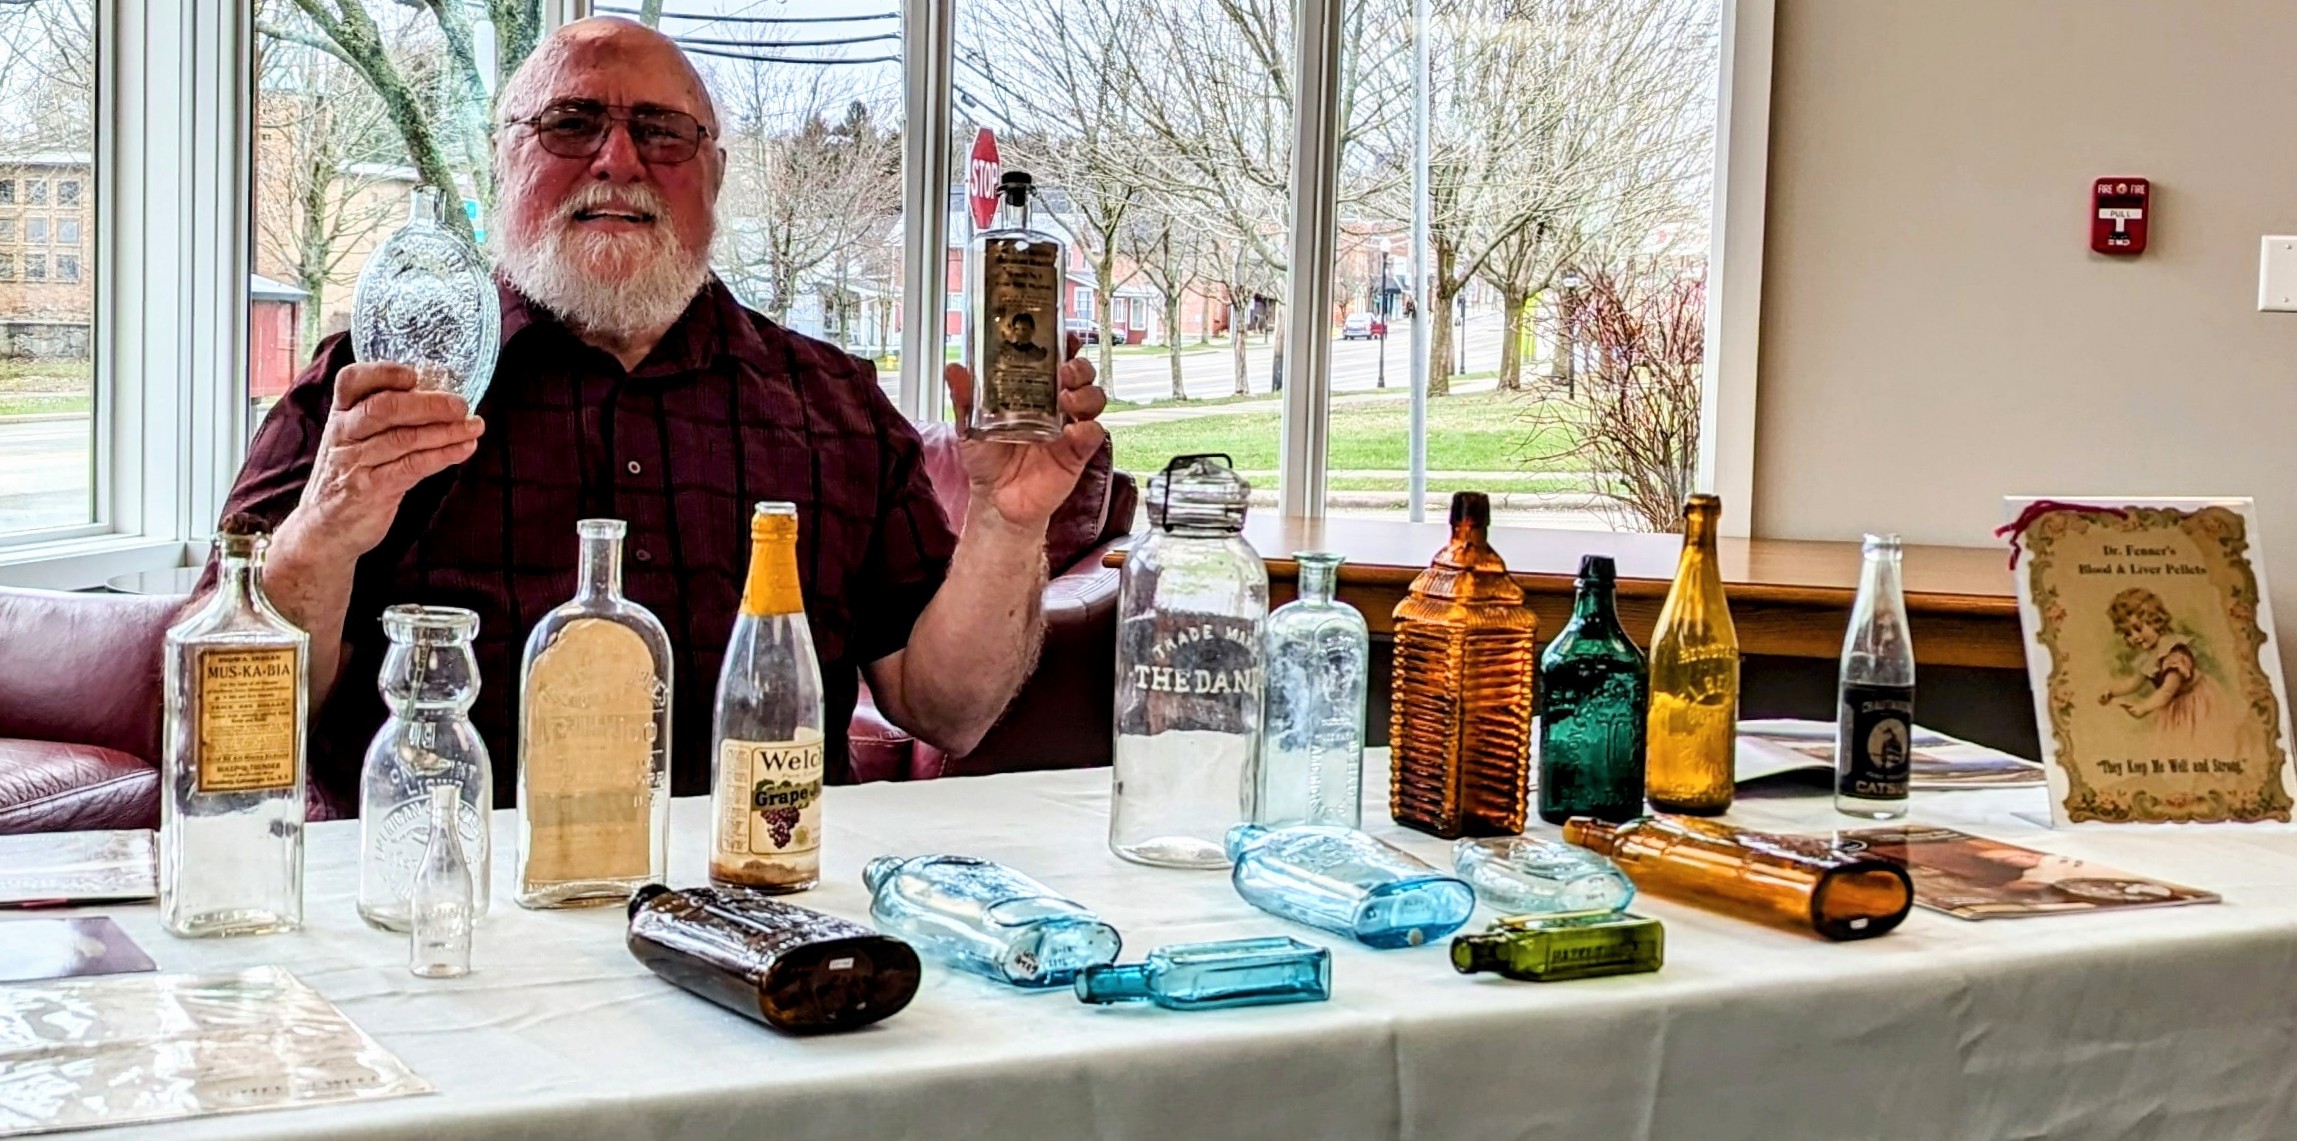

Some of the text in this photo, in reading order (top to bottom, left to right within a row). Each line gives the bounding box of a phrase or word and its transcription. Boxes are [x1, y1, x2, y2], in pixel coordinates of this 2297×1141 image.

[971, 159, 998, 199] STOP
[2098, 184, 2145, 195] FIRE FIRE
[2103, 545, 2177, 556] Dr. Fenner's
[2078, 564, 2207, 575] Blood & Liver Pellets
[1151, 624, 1214, 659] TRADE
[2127, 759, 2148, 777] Keep
[2151, 759, 2165, 773] Me
[2168, 759, 2189, 773] Well
[2193, 759, 2209, 773] and
[754, 788, 809, 807] Grape
